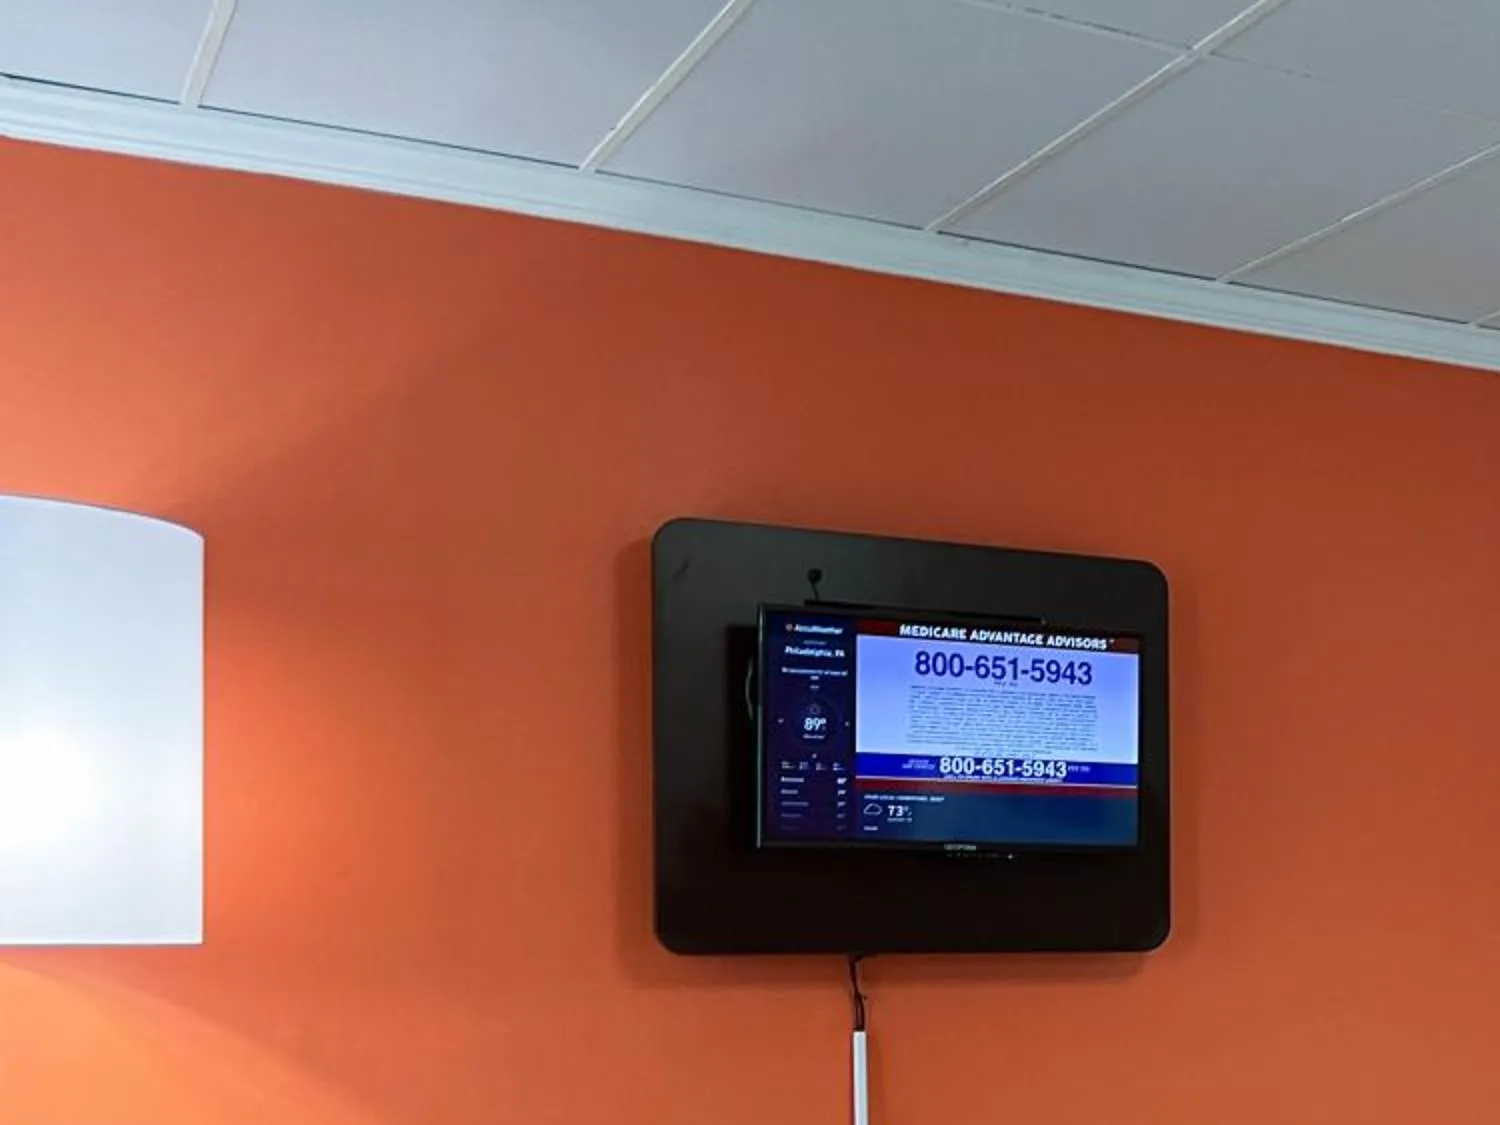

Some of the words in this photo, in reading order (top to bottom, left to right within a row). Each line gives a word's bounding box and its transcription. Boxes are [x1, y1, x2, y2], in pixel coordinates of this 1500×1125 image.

[900, 624, 967, 640] MEDICARE
[970, 629, 1044, 646] ADVANTAGE
[1047, 635, 1107, 650] ADVISORS
[915, 650, 1093, 686] 800-651-5943
[939, 757, 1068, 778] 800-651-5943
